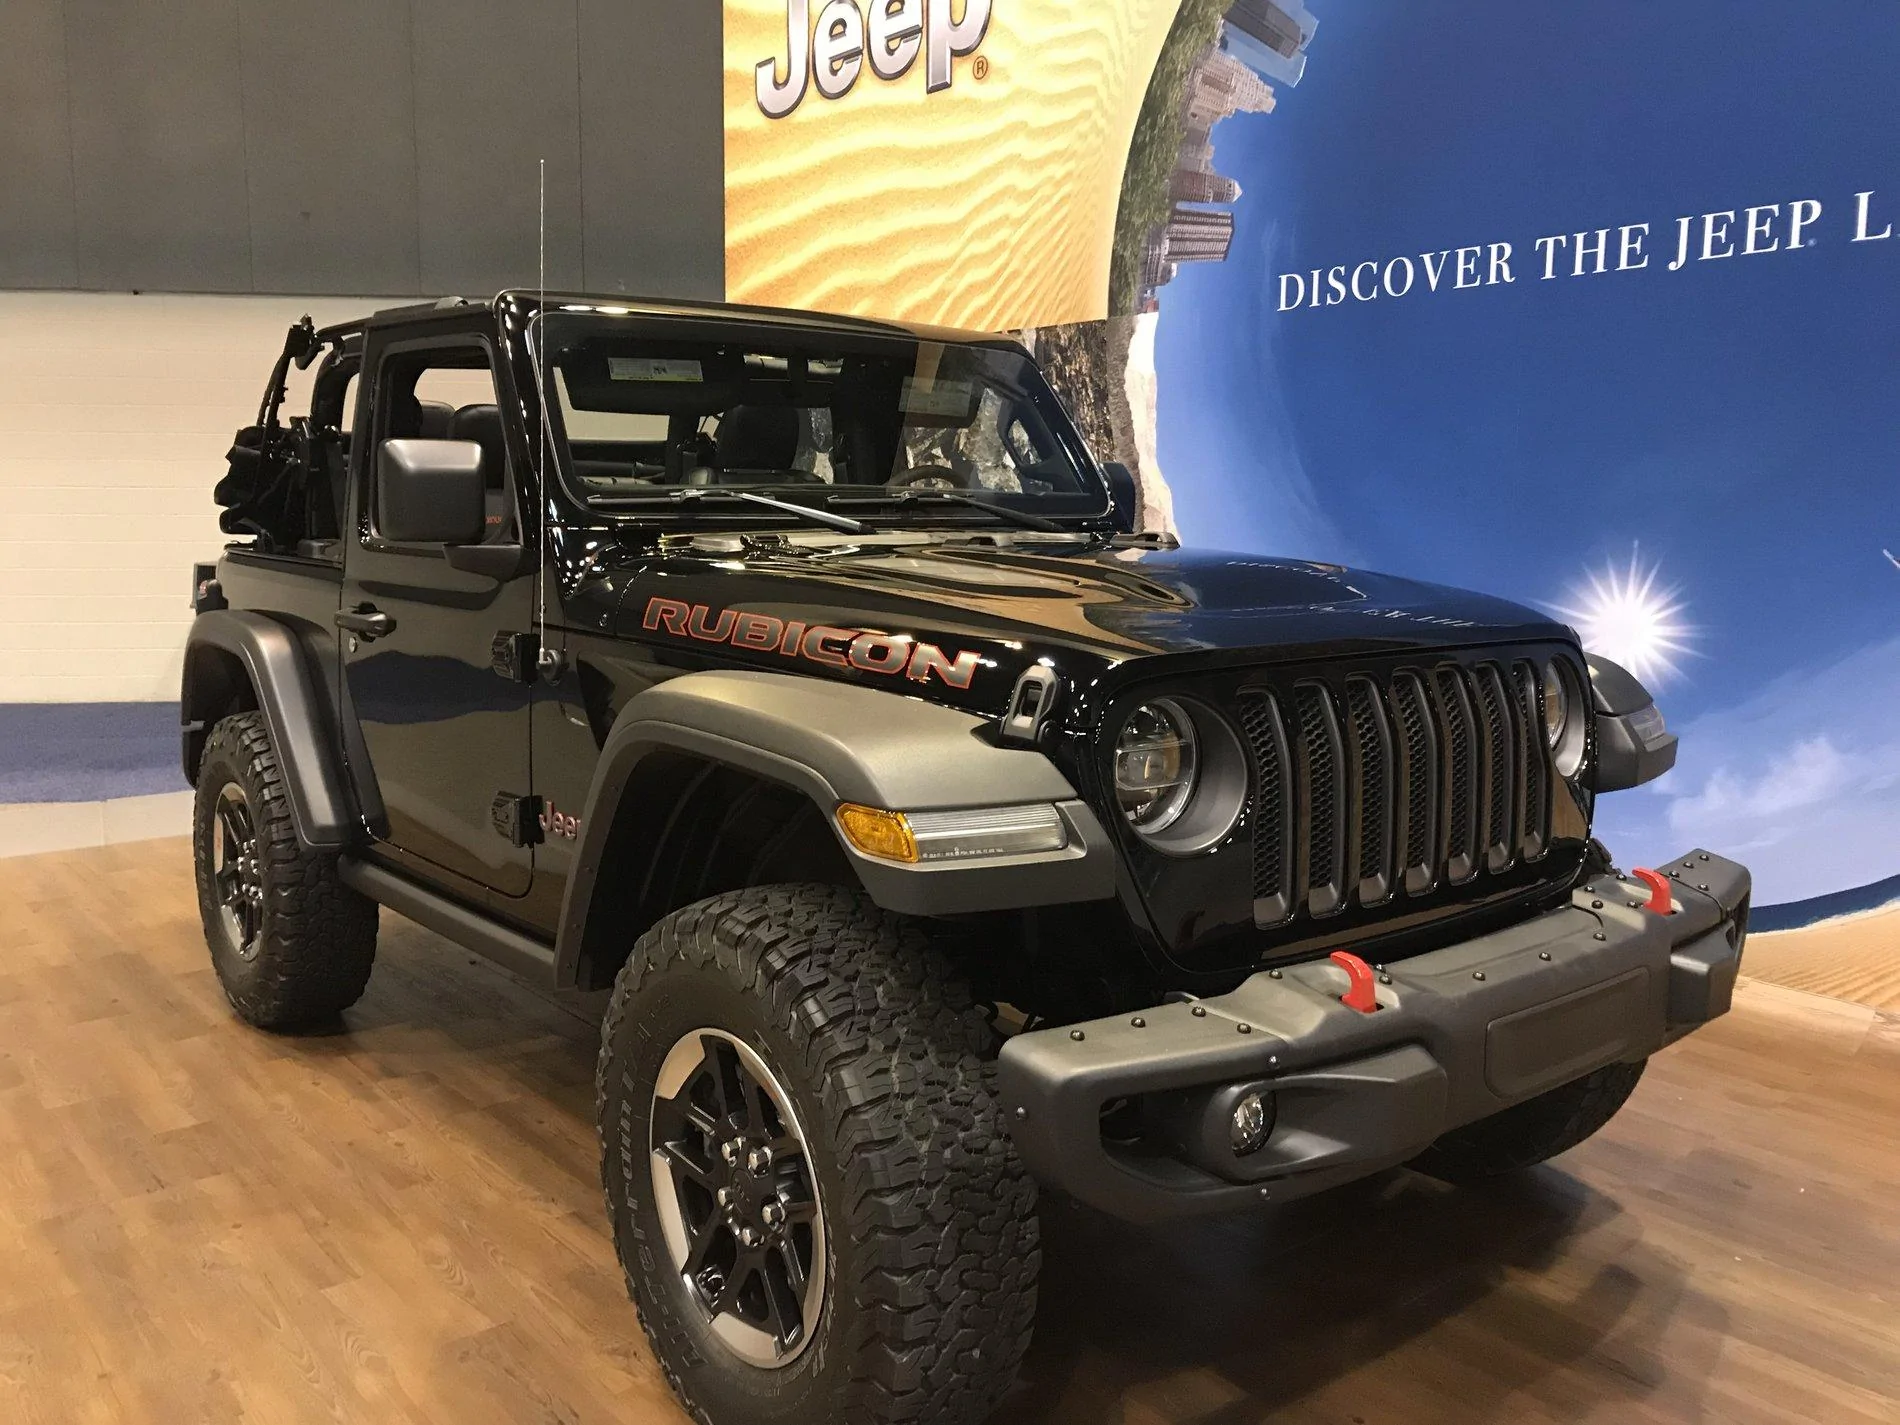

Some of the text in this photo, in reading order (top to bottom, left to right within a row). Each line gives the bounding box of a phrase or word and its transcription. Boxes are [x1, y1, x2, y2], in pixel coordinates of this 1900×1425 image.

[1276, 190, 1900, 312] DISCOVER THE JEEP L
[642, 596, 982, 690] RUBICON
